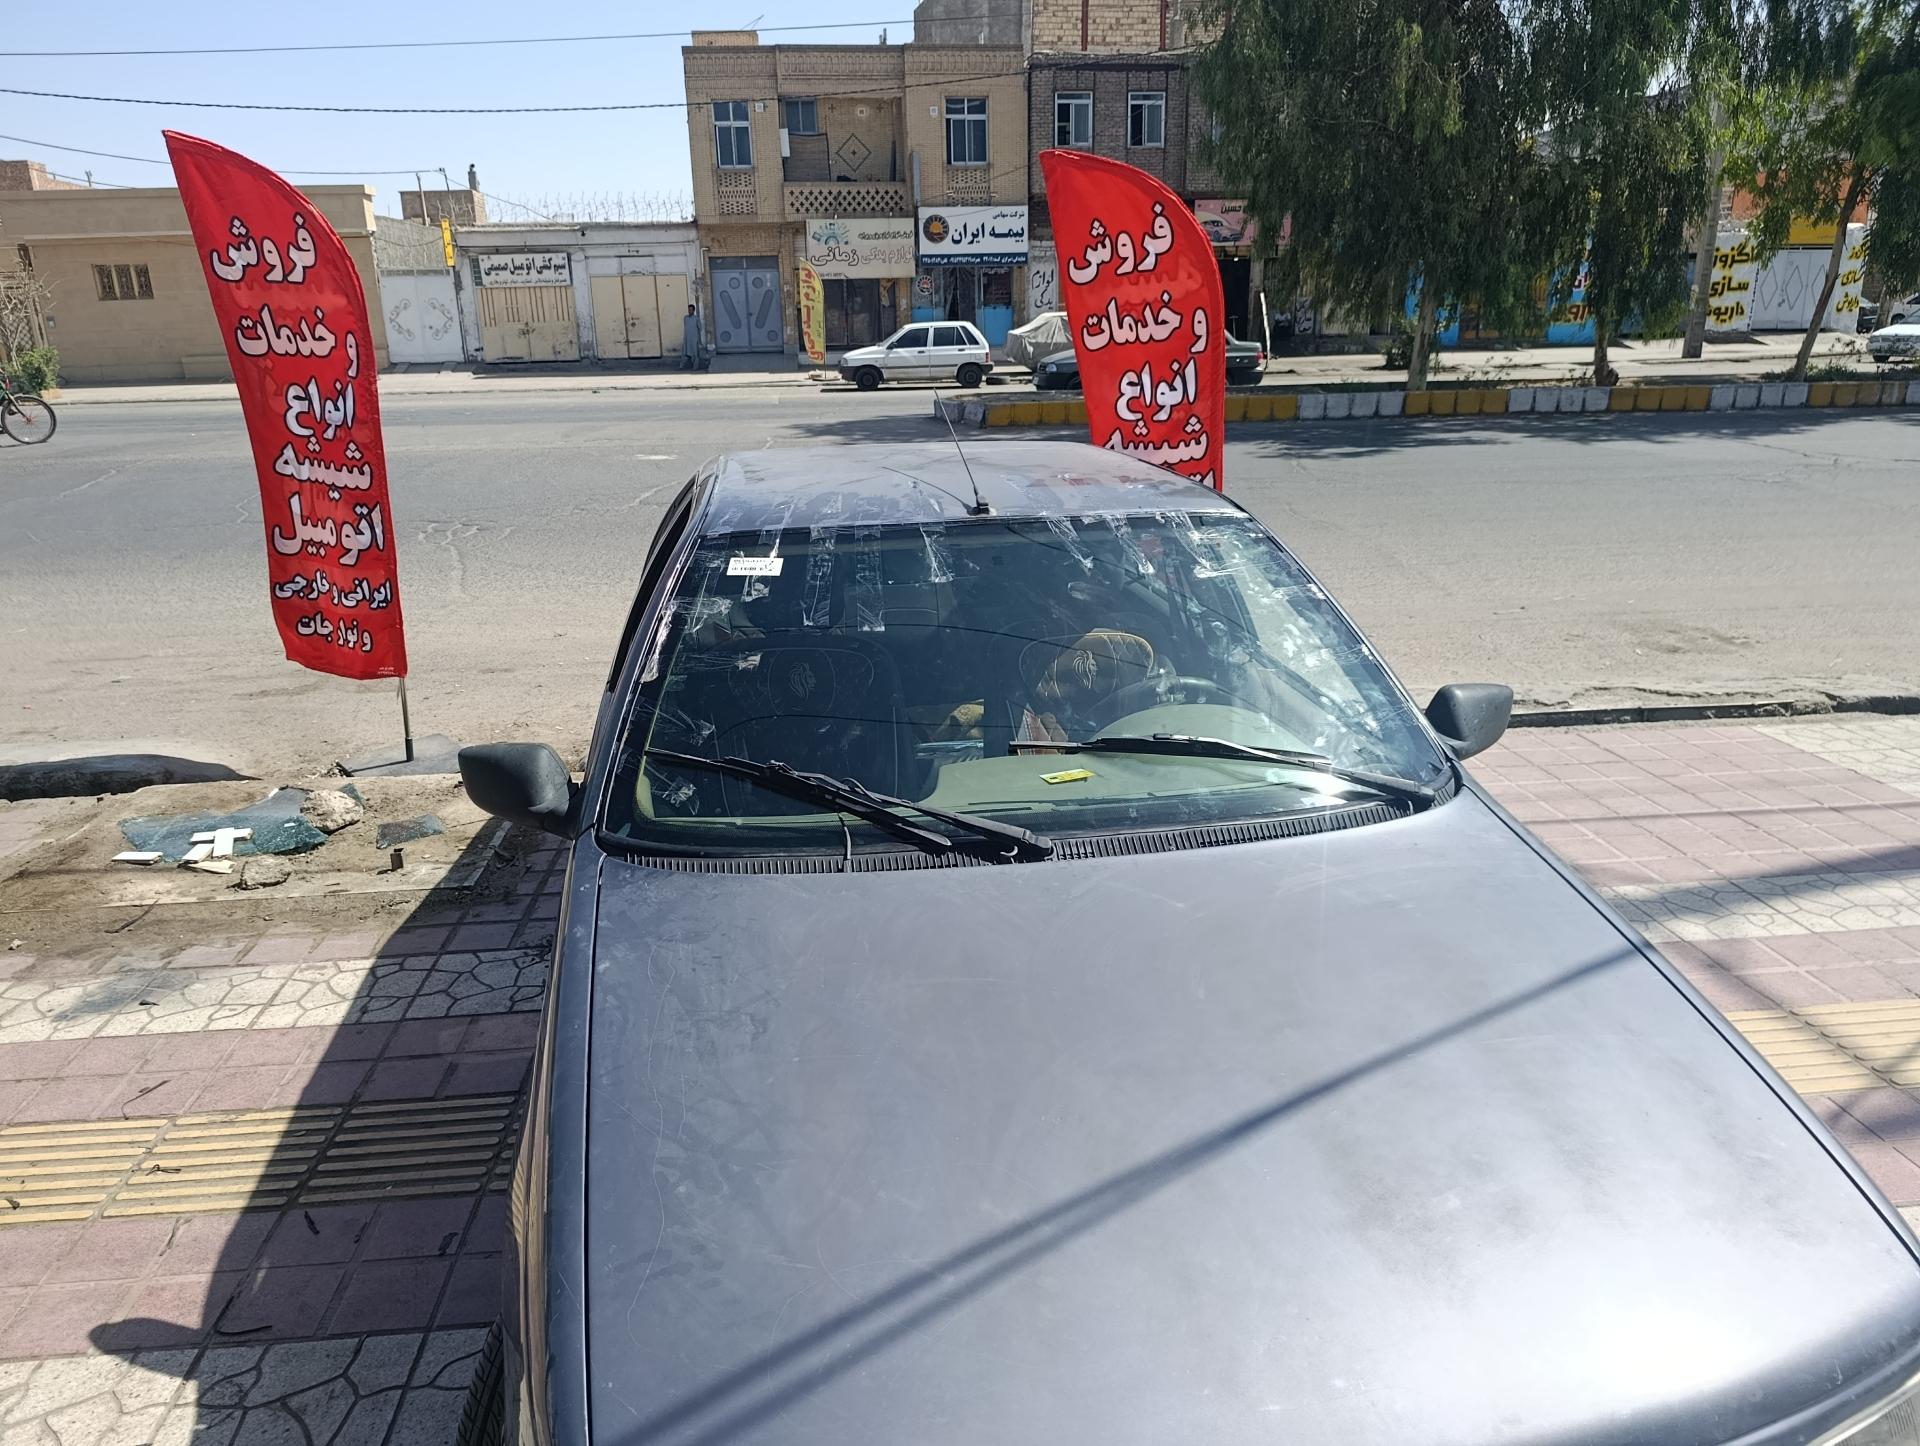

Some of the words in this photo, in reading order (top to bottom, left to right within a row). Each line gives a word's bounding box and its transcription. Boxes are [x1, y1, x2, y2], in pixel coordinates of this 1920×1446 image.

[211, 212, 317, 284] فروش
[951, 222, 985, 245] ایران
[988, 224, 1025, 243] بیمه
[1068, 201, 1175, 286] فروش
[509, 256, 536, 276] اتومبیل
[811, 246, 860, 267] زمانی
[888, 246, 913, 264] لوازم
[1032, 268, 1055, 290] لوازم
[1709, 276, 1750, 297] سازی
[1034, 288, 1054, 310] یدکی
[235, 304, 337, 357] خدمات
[1081, 290, 1183, 351] خدمات
[1191, 307, 1209, 353] و
[345, 329, 359, 378] و
[1114, 357, 1198, 422] انواع
[284, 377, 356, 440] انواع
[274, 439, 371, 499] شیشه
[273, 494, 384, 564] اتومبیل
[273, 568, 331, 600] خارجی
[331, 583, 340, 606] و
[340, 577, 393, 609] ایرانی
[360, 629, 373, 653] و
